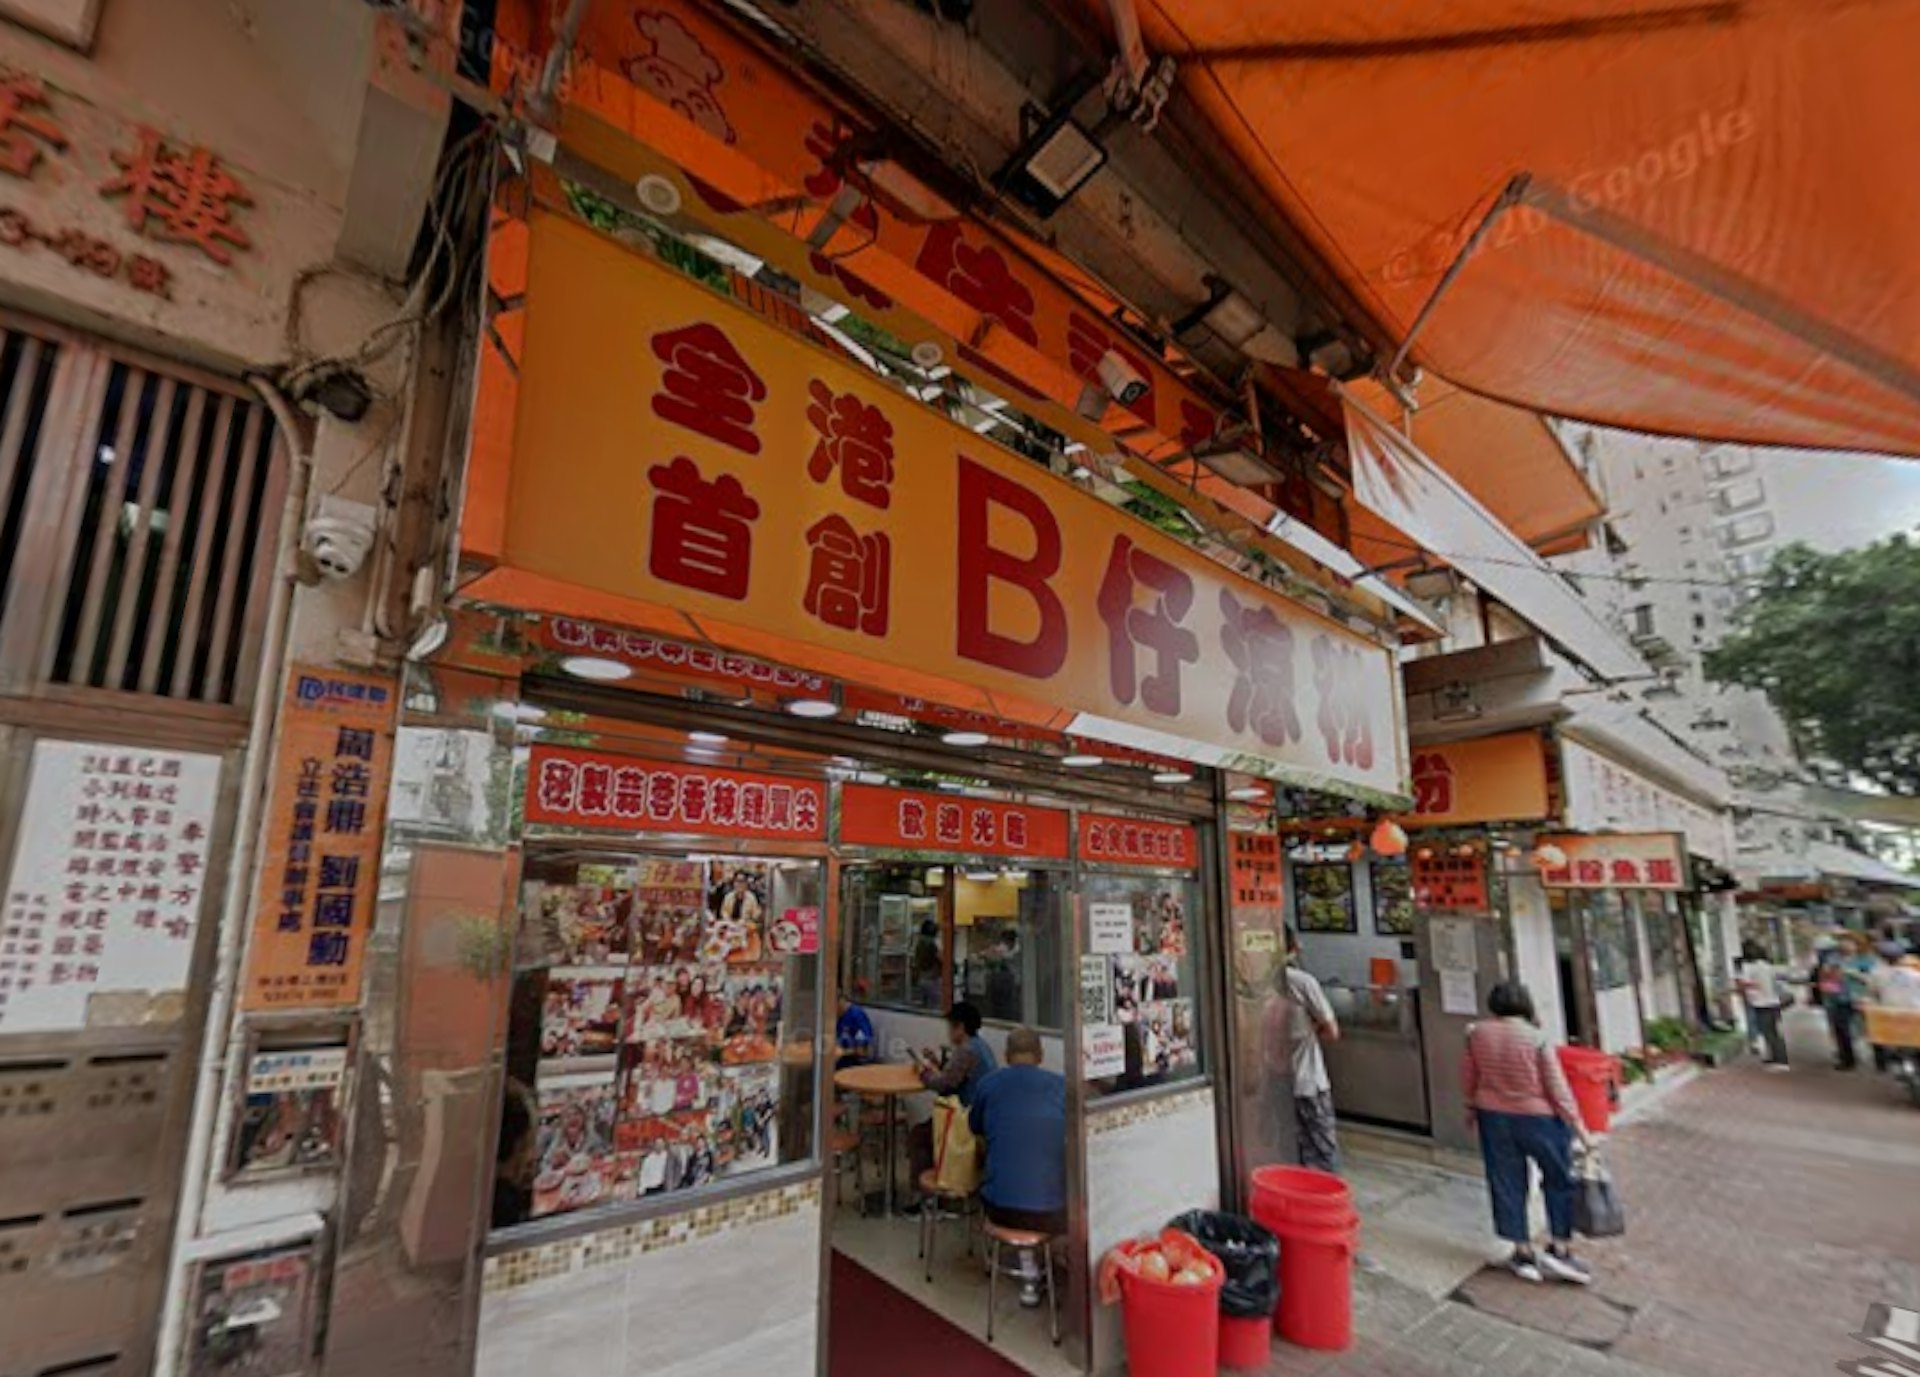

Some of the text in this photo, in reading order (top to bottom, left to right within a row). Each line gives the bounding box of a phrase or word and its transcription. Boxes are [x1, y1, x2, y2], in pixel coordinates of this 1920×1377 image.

[650, 322, 895, 510] 全港
[647, 455, 892, 638] 首創
[900, 799, 1028, 850] 歡迎光臨
